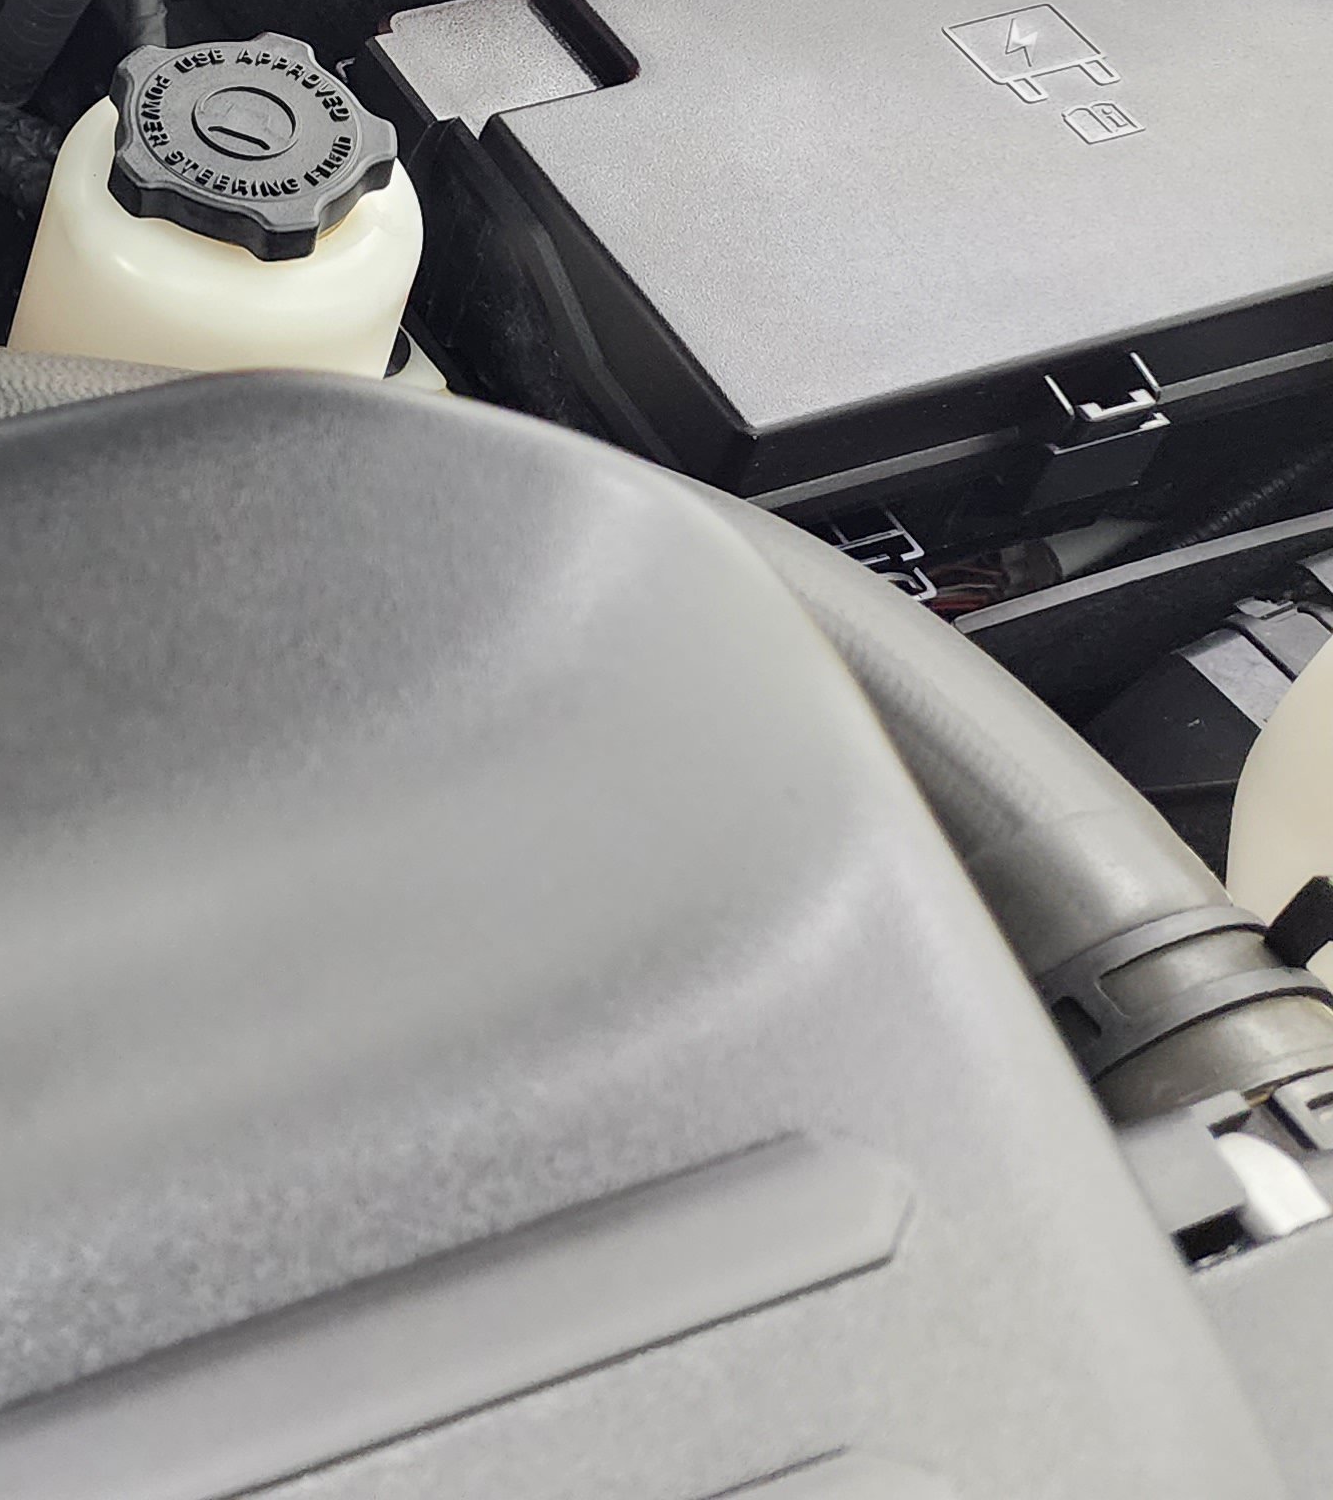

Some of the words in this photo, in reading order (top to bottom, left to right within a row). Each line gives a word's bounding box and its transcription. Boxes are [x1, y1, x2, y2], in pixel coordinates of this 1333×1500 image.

[174, 49, 226, 74] USE
[236, 49, 351, 122] APPROVED
[140, 75, 173, 148] POWER
[165, 150, 301, 198] STEERING
[303, 136, 353, 186] FLUID
